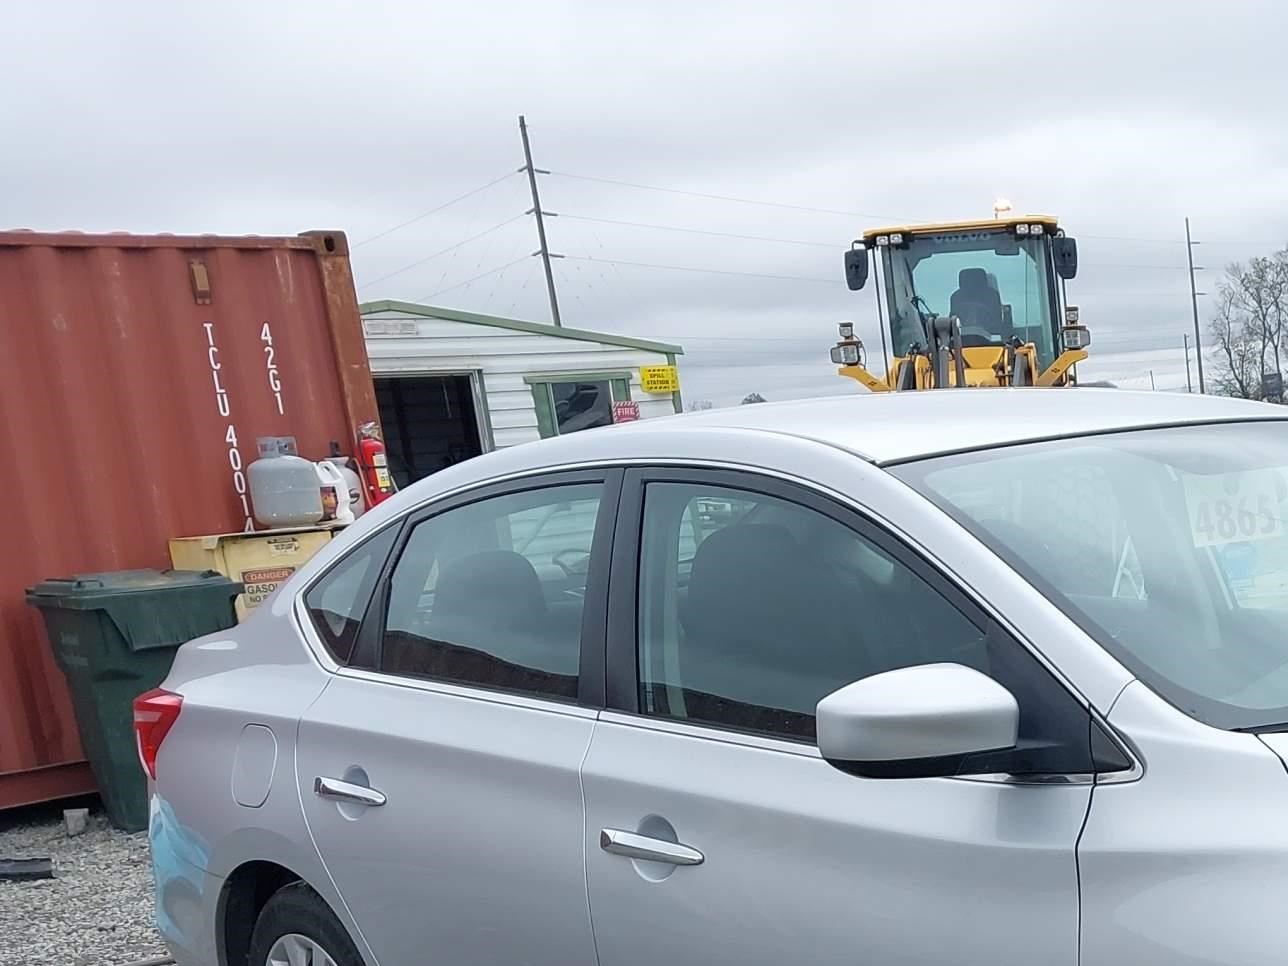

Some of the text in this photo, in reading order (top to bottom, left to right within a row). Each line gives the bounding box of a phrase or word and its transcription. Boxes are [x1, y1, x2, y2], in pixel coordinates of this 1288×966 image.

[203, 323, 230, 416] TCLU
[260, 323, 284, 415] 42G1
[617, 407, 636, 416] FIRE
[1197, 494, 1277, 541] 4865
[249, 570, 290, 581] DANGER
